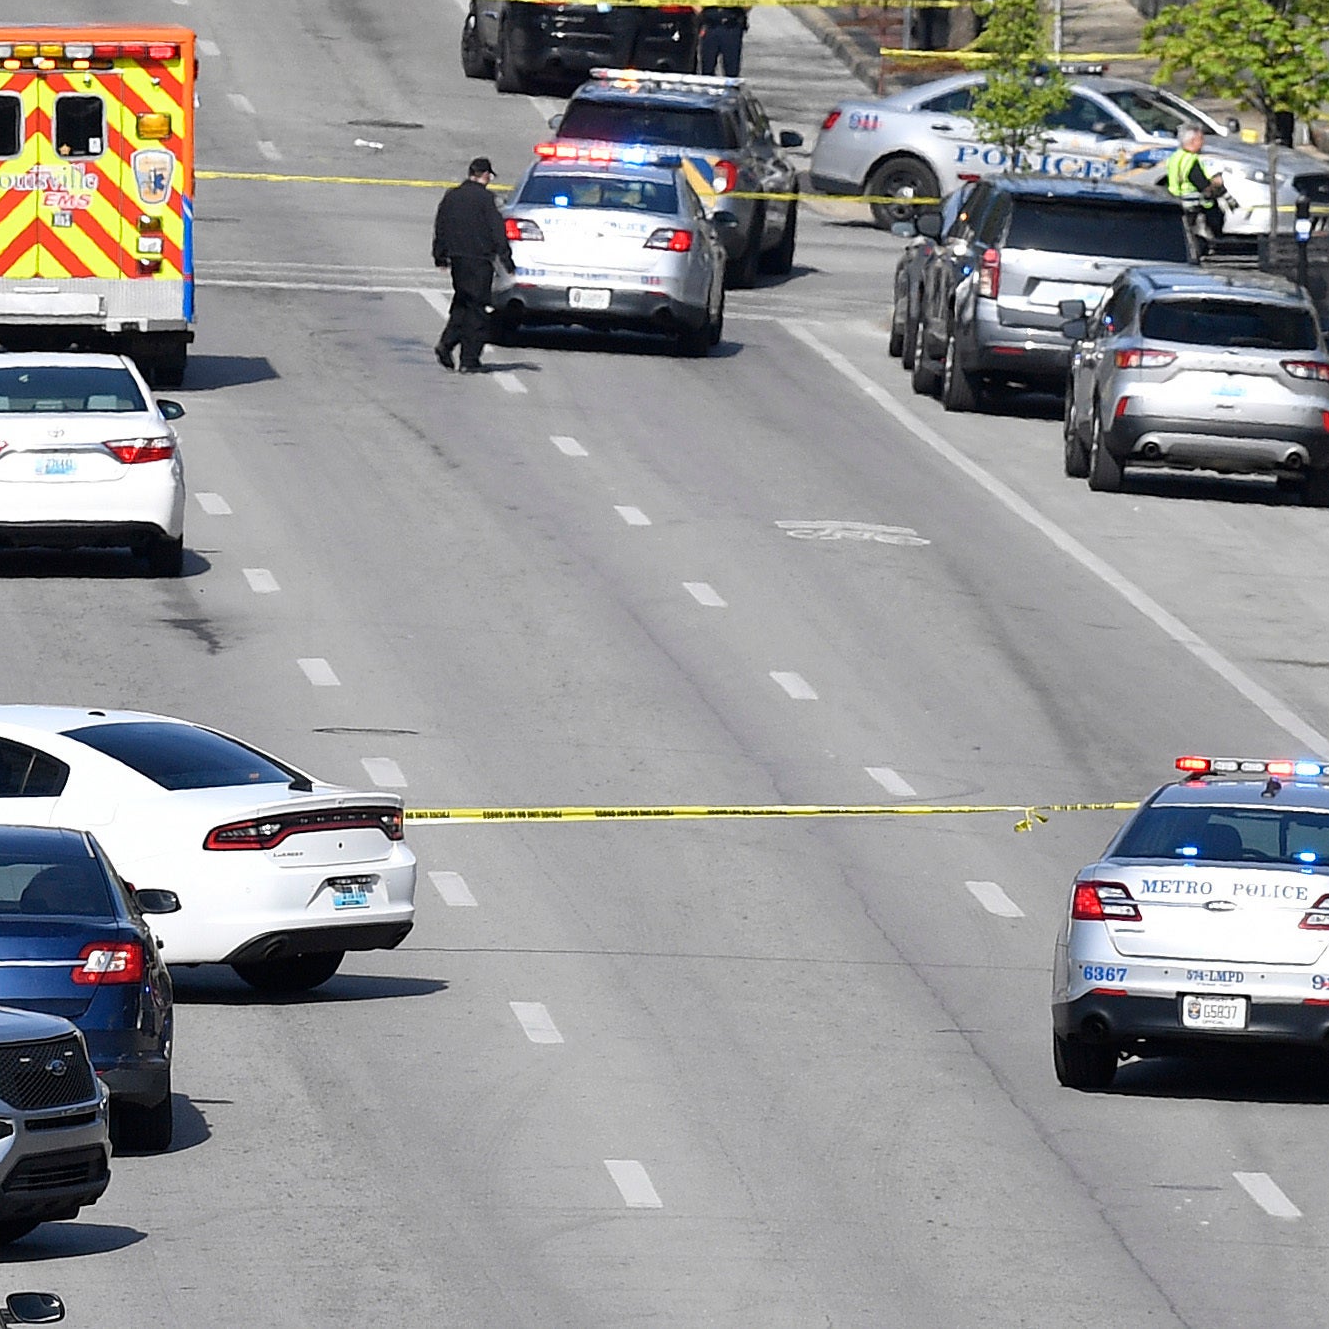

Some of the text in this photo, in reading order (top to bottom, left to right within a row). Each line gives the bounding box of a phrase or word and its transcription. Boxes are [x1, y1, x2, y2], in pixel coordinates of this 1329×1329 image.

[43, 192, 91, 209] EMS
[1141, 878, 1308, 901] METRO POLICE
[1083, 966, 1127, 983] 6367
[1186, 970, 1244, 984] 574-LMPD
